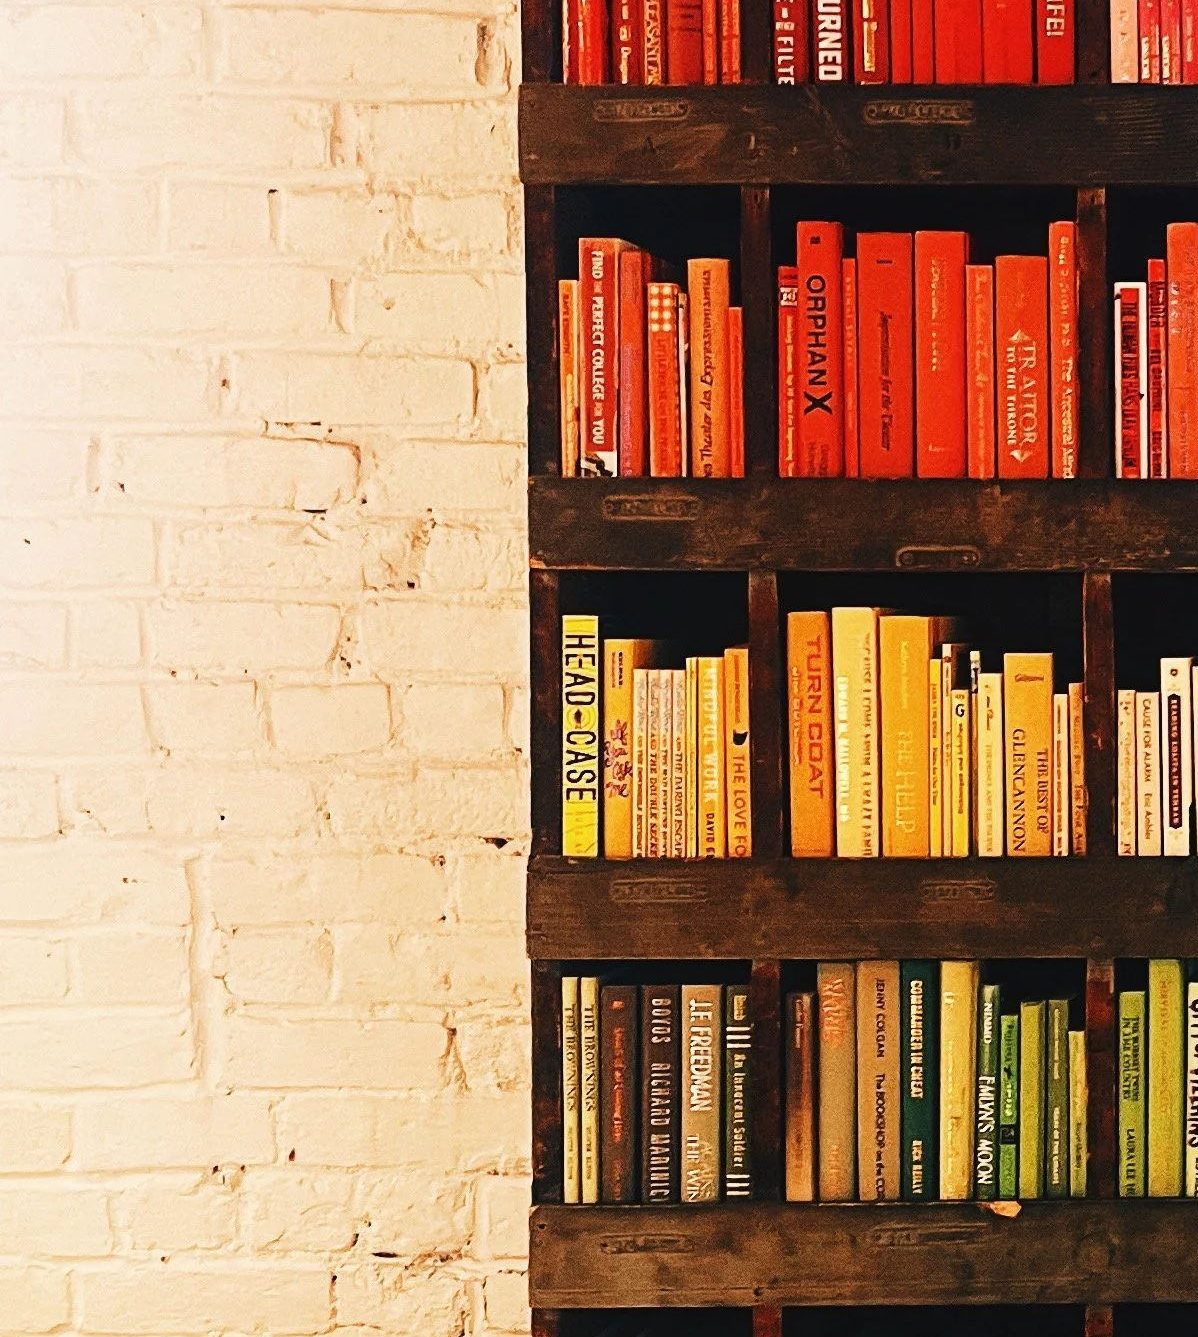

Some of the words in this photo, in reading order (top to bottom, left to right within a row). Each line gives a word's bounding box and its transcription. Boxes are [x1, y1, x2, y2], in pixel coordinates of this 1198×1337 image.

[592, 250, 604, 279] FIND
[592, 296, 604, 345] PERFECT
[807, 275, 828, 386] ORPHAN
[593, 349, 604, 400] COLLEGE
[1007, 347, 1015, 363] TO
[1007, 368, 1016, 390] THE
[1021, 341, 1036, 444] TRAITOR
[804, 391, 832, 415] X
[1007, 396, 1017, 445] THRONE
[593, 419, 604, 444] YOU
[807, 634, 822, 714] TURN
[1142, 699, 1152, 727] CAUSE
[1143, 731, 1152, 748] FOR
[566, 731, 596, 801] CASE
[733, 755, 745, 784] THE
[809, 722, 823, 797] COAT
[1036, 748, 1048, 778] THE
[1143, 752, 1153, 782] ALARM
[734, 790, 746, 829] LOVE
[1012, 729, 1026, 852] GLENCANNON
[1037, 781, 1048, 812] BEST
[1038, 815, 1049, 833] OF
[651, 998, 671, 1043] BOYOS
[690, 998, 712, 1021] J.F.
[911, 981, 922, 1050] COMMANDER
[690, 1027, 712, 1111] FREEDMAN
[911, 1052, 922, 1064] IN
[651, 1063, 671, 1126] RICHARD
[911, 1066, 922, 1098] CHEAT
[978, 1076, 995, 1132] EMLYN'S
[977, 1139, 993, 1185] MOON
